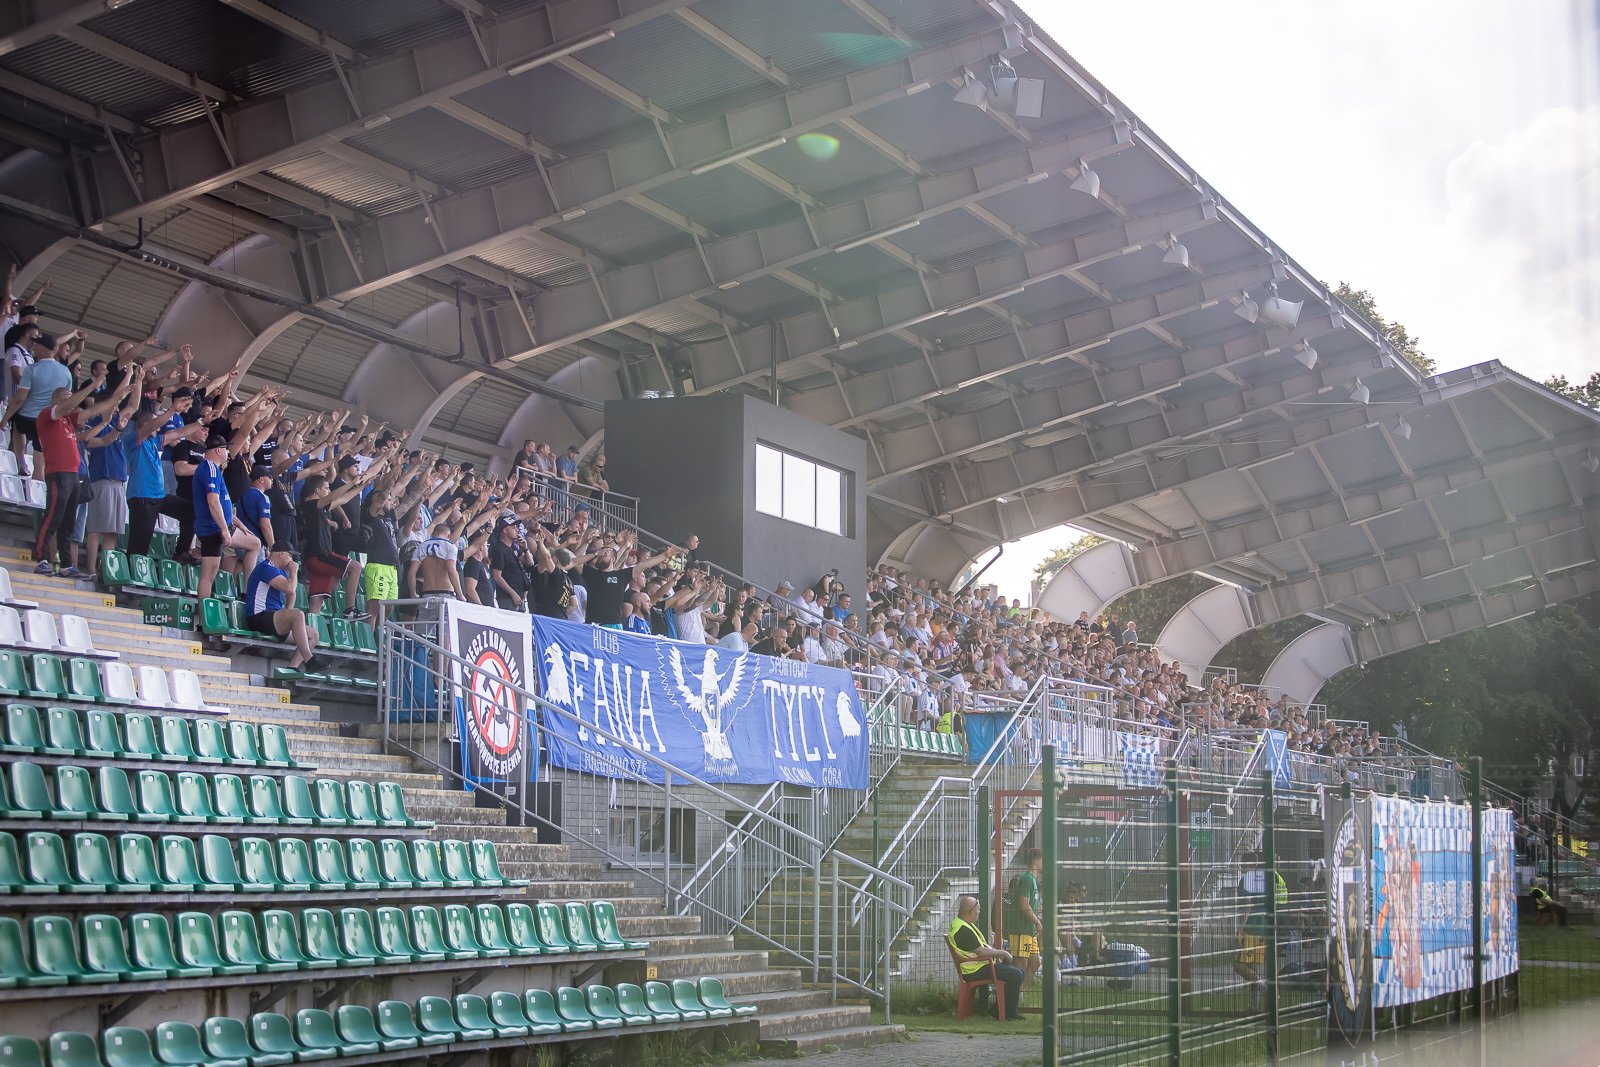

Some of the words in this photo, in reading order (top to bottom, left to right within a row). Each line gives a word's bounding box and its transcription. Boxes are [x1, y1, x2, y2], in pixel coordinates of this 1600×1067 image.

[377, 575, 385, 597] ICON
[145, 614, 168, 624] LECH
[180, 615, 191, 624] LECH
[482, 630, 489, 649] Z
[769, 656, 808, 679] SPORTOWY
[569, 650, 667, 753] FANA
[762, 679, 837, 762] TYCY
[822, 766, 842, 786] GÓRA
